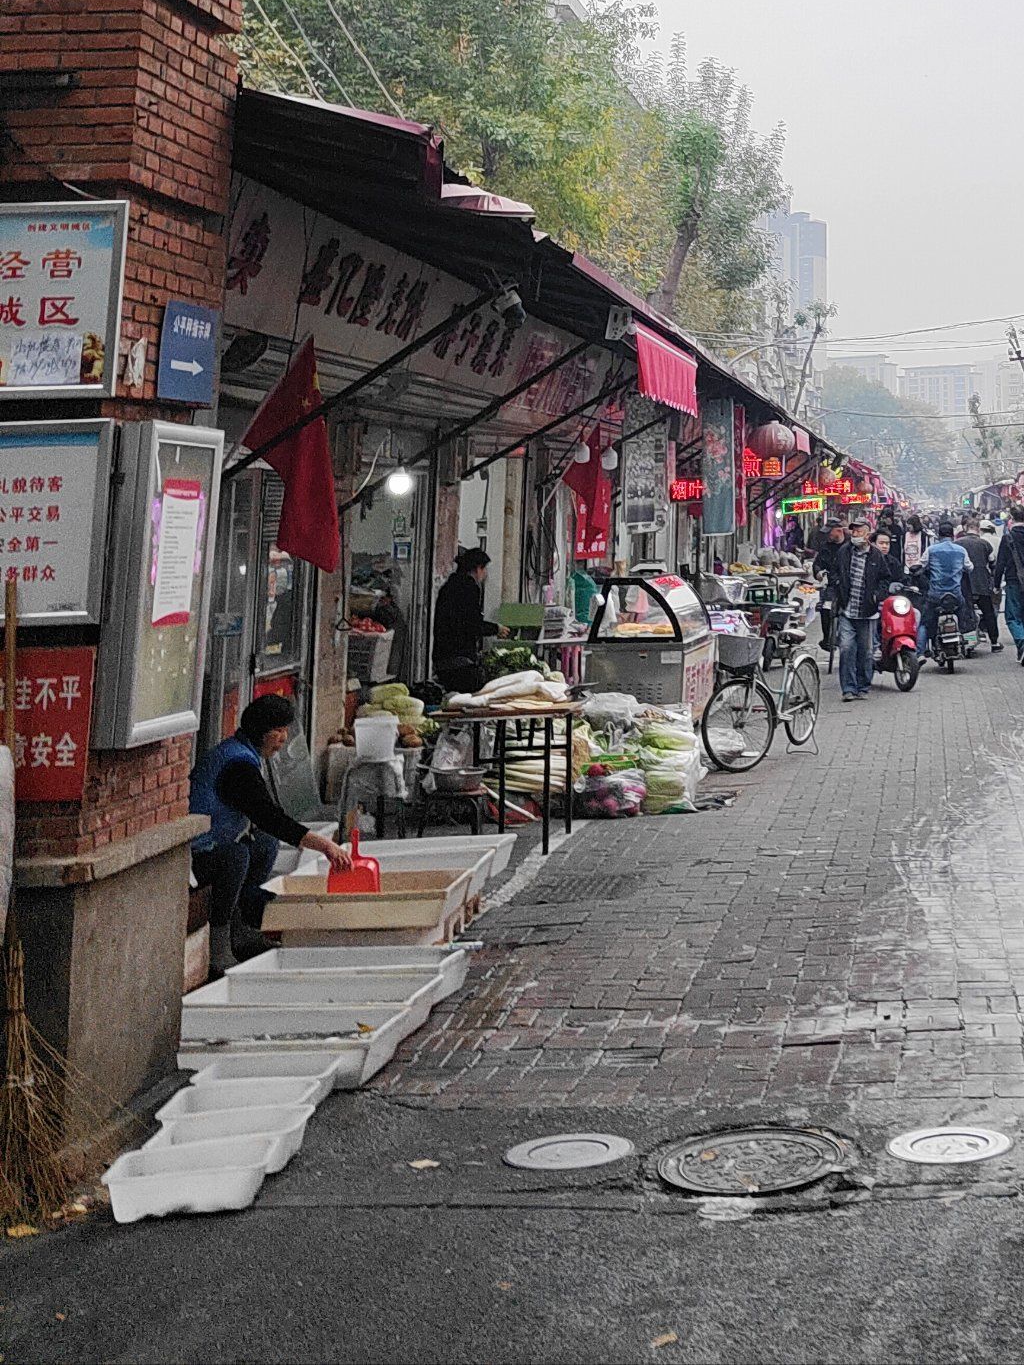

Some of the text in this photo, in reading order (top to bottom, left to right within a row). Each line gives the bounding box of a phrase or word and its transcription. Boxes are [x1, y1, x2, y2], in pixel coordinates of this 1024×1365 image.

[671, 480, 703, 500] 烟叶
[0, 536, 58, 552] 全第一
[0, 565, 56, 582] 务群众
